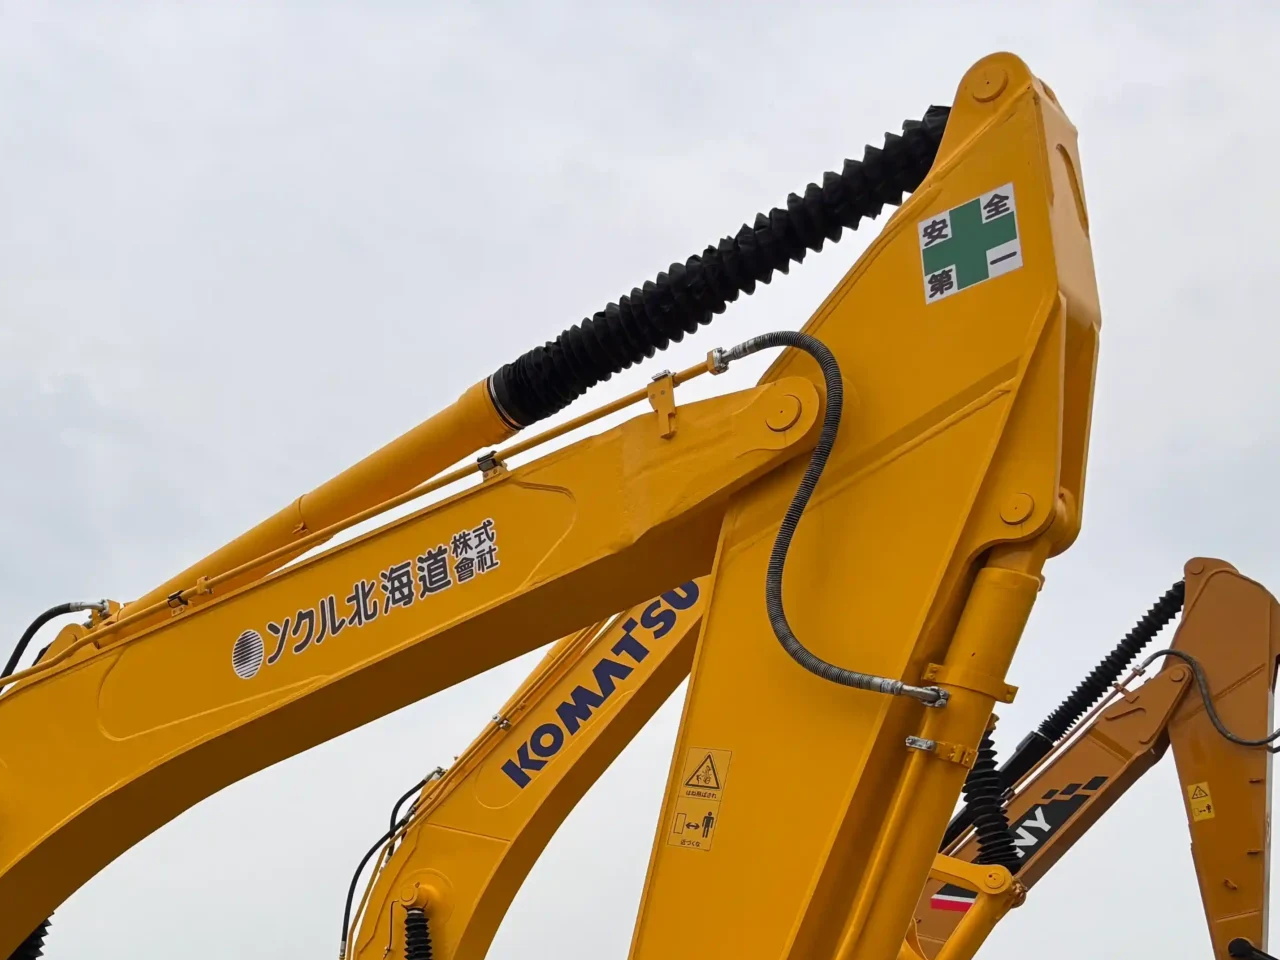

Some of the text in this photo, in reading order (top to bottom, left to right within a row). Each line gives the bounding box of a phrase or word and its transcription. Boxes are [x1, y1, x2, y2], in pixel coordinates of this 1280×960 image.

[923, 193, 1010, 246] 安 全
[927, 268, 954, 298] 第
[501, 580, 700, 789] KOMATSU
